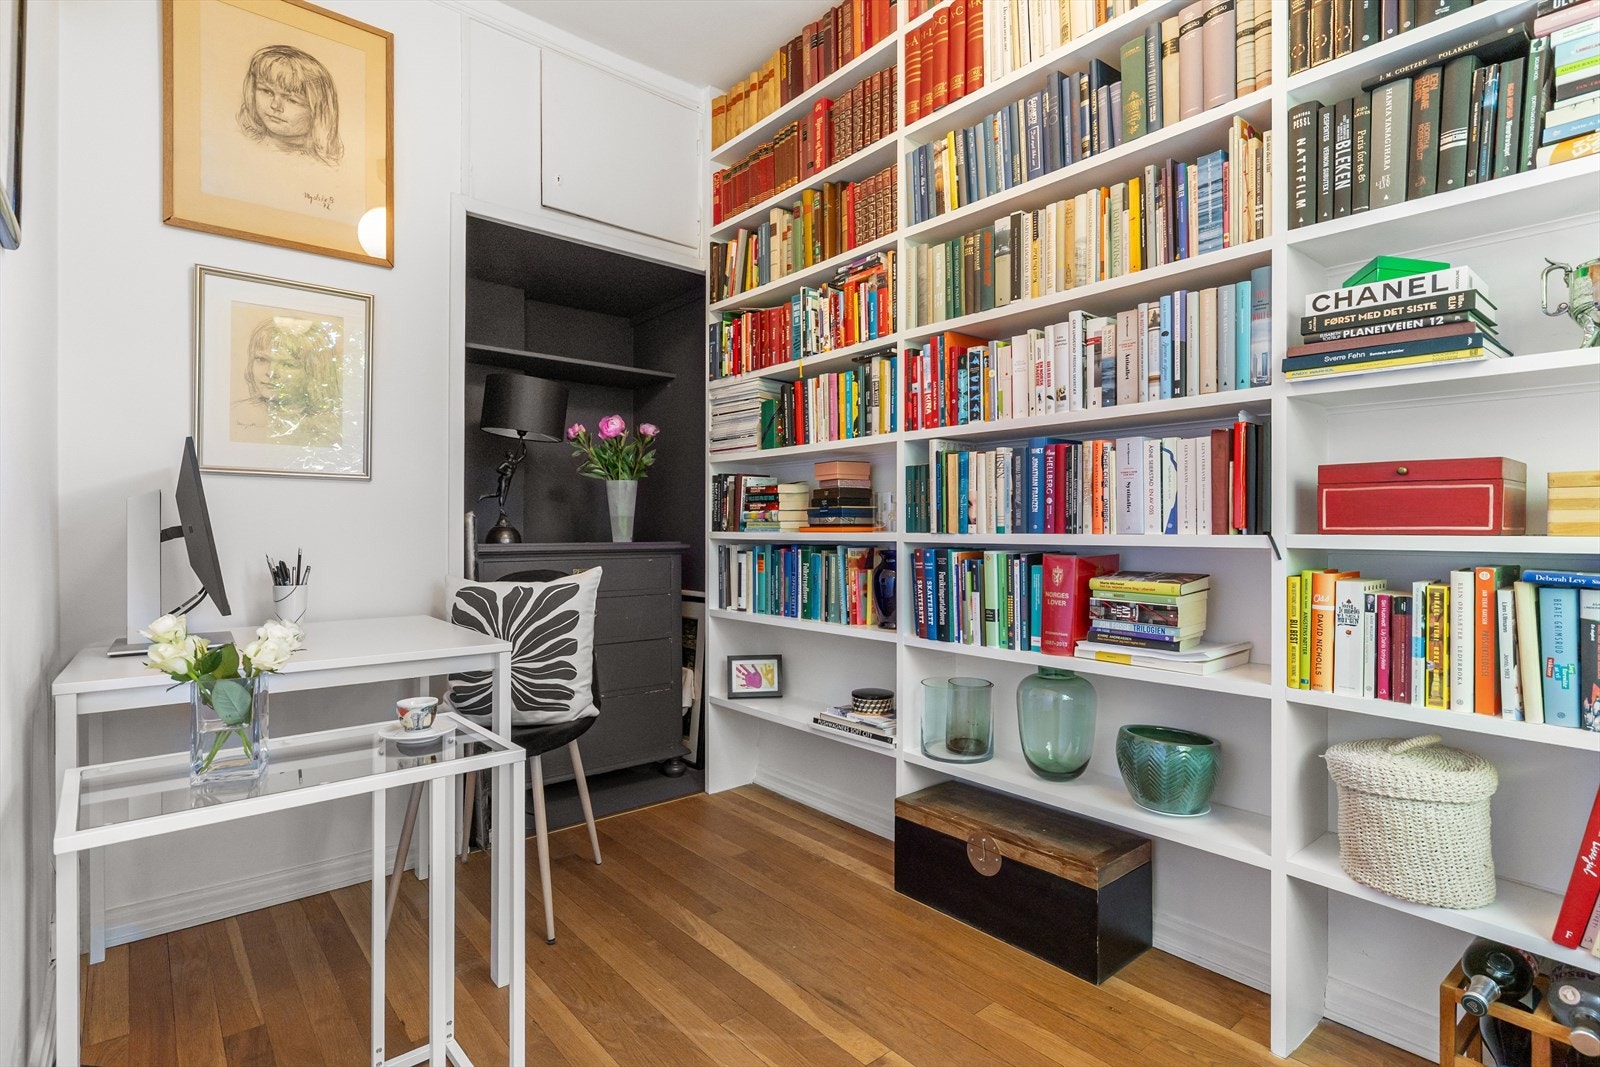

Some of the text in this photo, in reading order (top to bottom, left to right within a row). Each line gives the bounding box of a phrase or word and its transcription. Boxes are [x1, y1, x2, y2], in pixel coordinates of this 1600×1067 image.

[1394, 58, 1428, 75] COETZEE
[1438, 40, 1480, 59] POLAKKEN
[1430, 72, 1439, 90] DEN
[1293, 116, 1311, 130] PESSL
[1357, 129, 1367, 150] Paris
[1384, 116, 1392, 171] YANAGIHARA
[1335, 140, 1351, 191] BLEKEN
[1358, 151, 1367, 163] for
[1296, 137, 1306, 209] NATTFILM
[1312, 274, 1449, 313] CHANEL
[1324, 302, 1438, 327] FØRST MED DET SISTE
[1343, 316, 1444, 339] PLANETVEIEN 12
[1324, 354, 1346, 363] Sverre
[1347, 351, 1366, 360] Fehn
[996, 453, 1005, 479] IBSEN
[1046, 456, 1054, 495] HELLBERG
[1535, 574, 1567, 584] Deborah
[1568, 576, 1587, 585] Levy
[916, 580, 924, 624] SKATTERETT
[926, 580, 934, 626] SKATTERETT
[1045, 591, 1070, 599] NORGES
[1047, 599, 1067, 607] LOVER
[1122, 605, 1131, 618] LIV
[1132, 624, 1166, 635] TRILOGIEN
[1290, 619, 1298, 629] BLI
[1433, 592, 1442, 664] MIKAEL NIEMI KOKE
[1553, 598, 1564, 654] BEATE GRIMSRUD
[1290, 629, 1298, 644] BEST
[1315, 613, 1324, 676] DAVID NICHOLLS
[817, 719, 850, 733] PUSHWAGNERS
[861, 730, 873, 739] CITY
